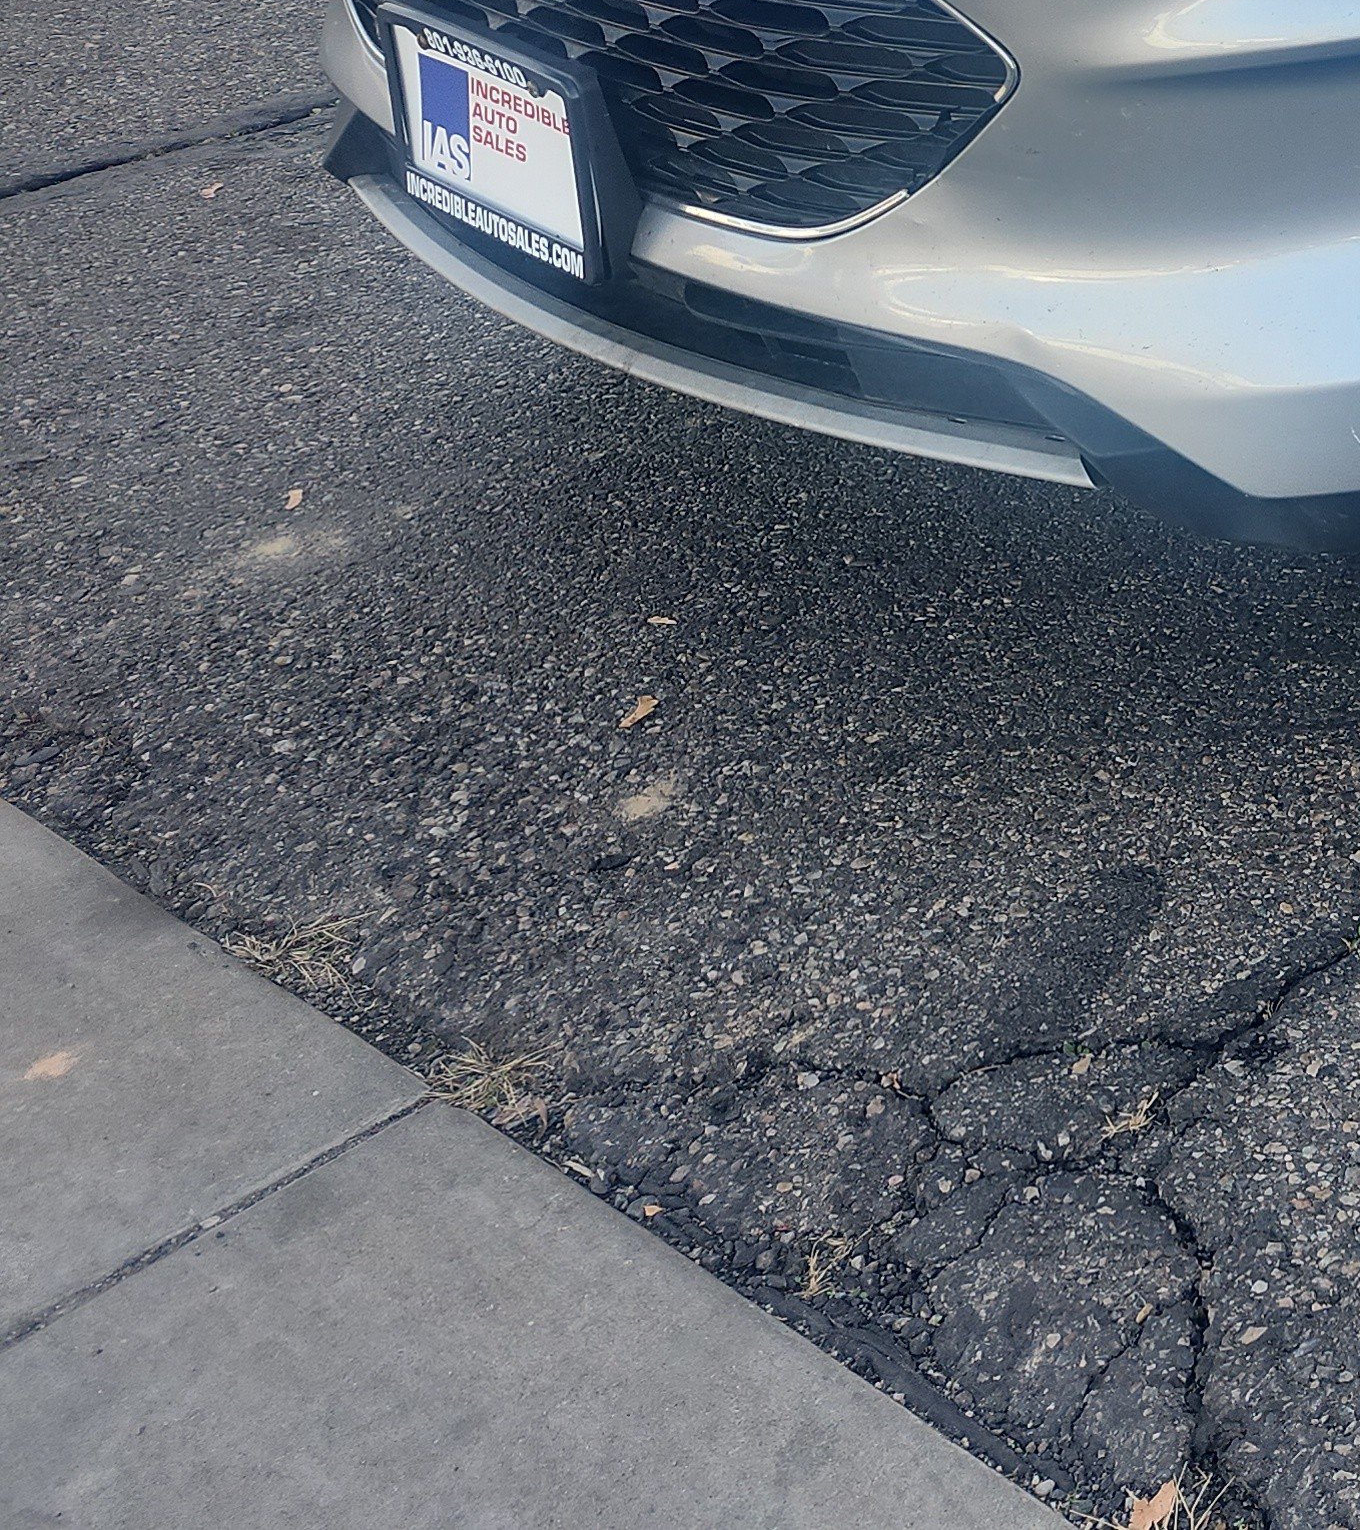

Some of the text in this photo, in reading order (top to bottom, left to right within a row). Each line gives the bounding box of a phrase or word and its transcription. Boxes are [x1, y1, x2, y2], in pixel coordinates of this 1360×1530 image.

[423, 27, 527, 88] 801-936-6100
[471, 76, 570, 136] INCREDIBLE
[472, 102, 517, 134] AUTO
[422, 120, 471, 181] IAS
[472, 125, 527, 162] SALES
[405, 170, 585, 280] INCREDIBLEAUTOSALES.COM
